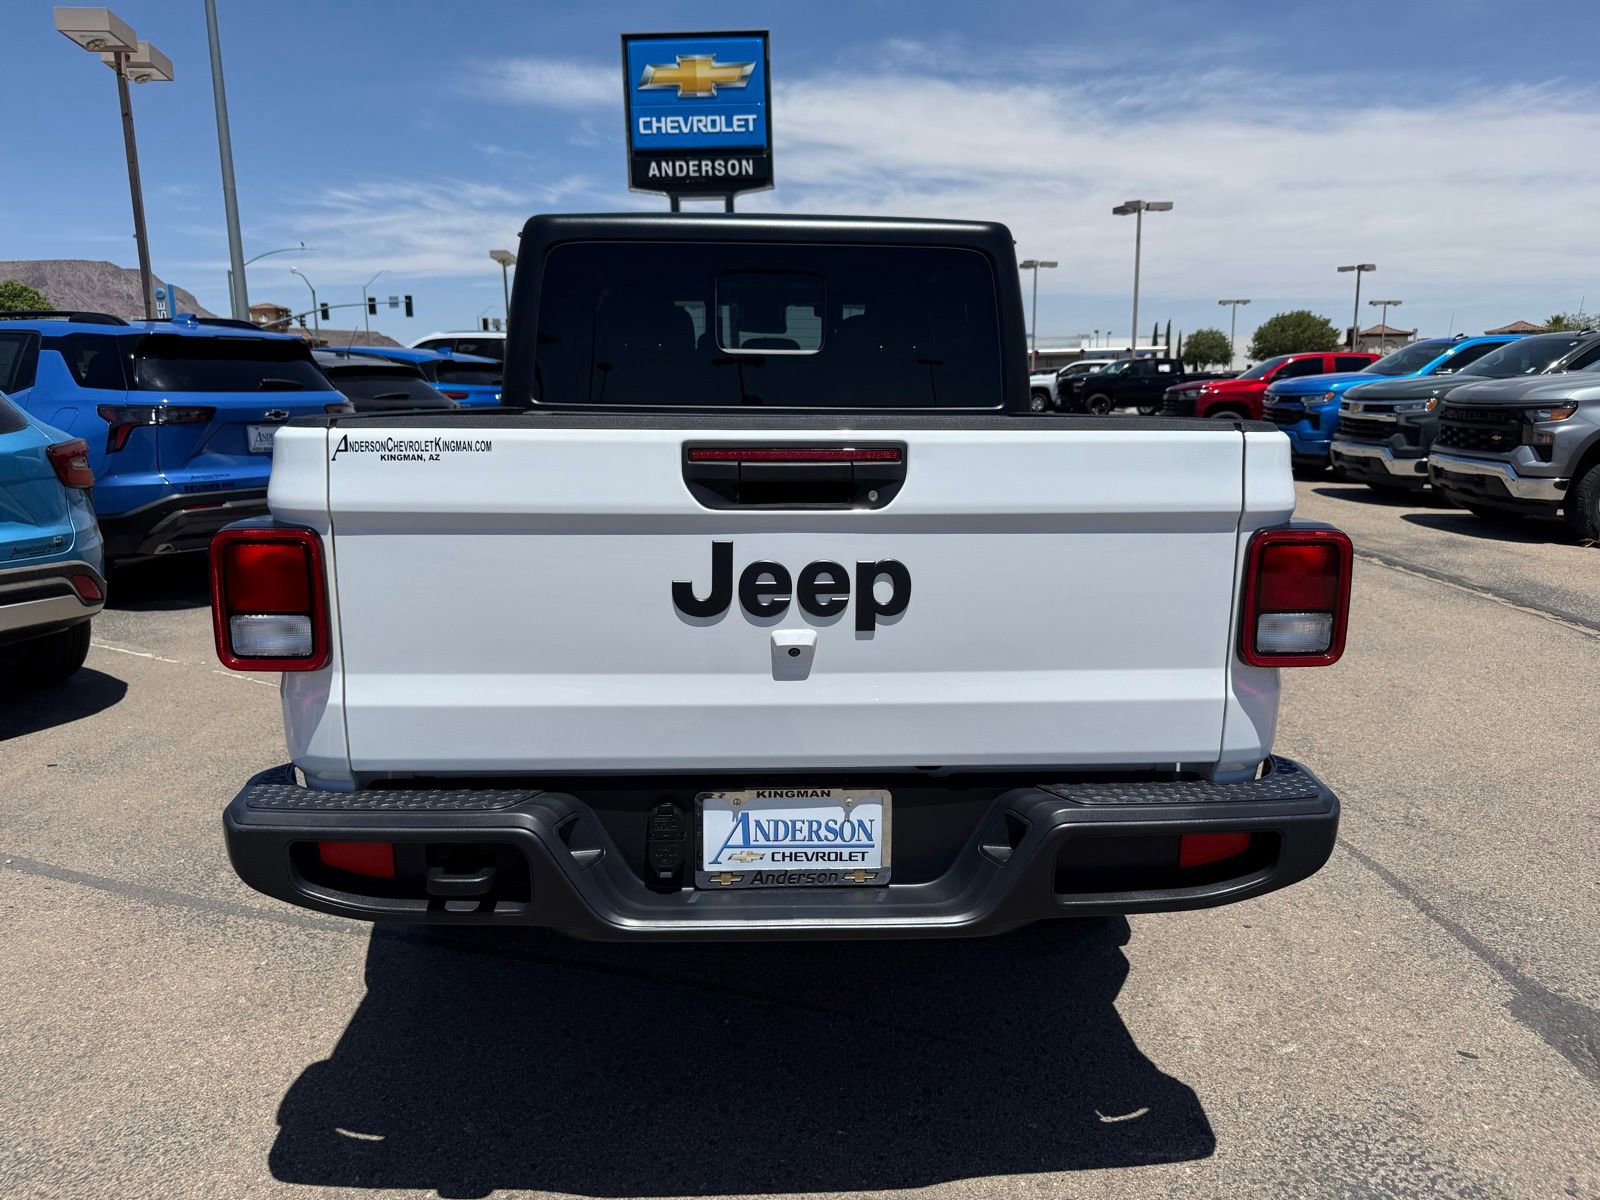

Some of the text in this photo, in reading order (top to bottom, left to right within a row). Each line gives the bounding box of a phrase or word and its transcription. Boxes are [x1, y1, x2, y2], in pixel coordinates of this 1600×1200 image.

[639, 114, 757, 135] CHEVROLET
[648, 159, 754, 178] ANDERSON
[380, 454, 426, 462] KINGMAN,
[672, 540, 912, 631] Jeep
[756, 790, 832, 799] KINGMAN
[708, 812, 875, 864] ANDERSON
[771, 851, 869, 862] CHEVROLET
[751, 870, 839, 885] Anderson
